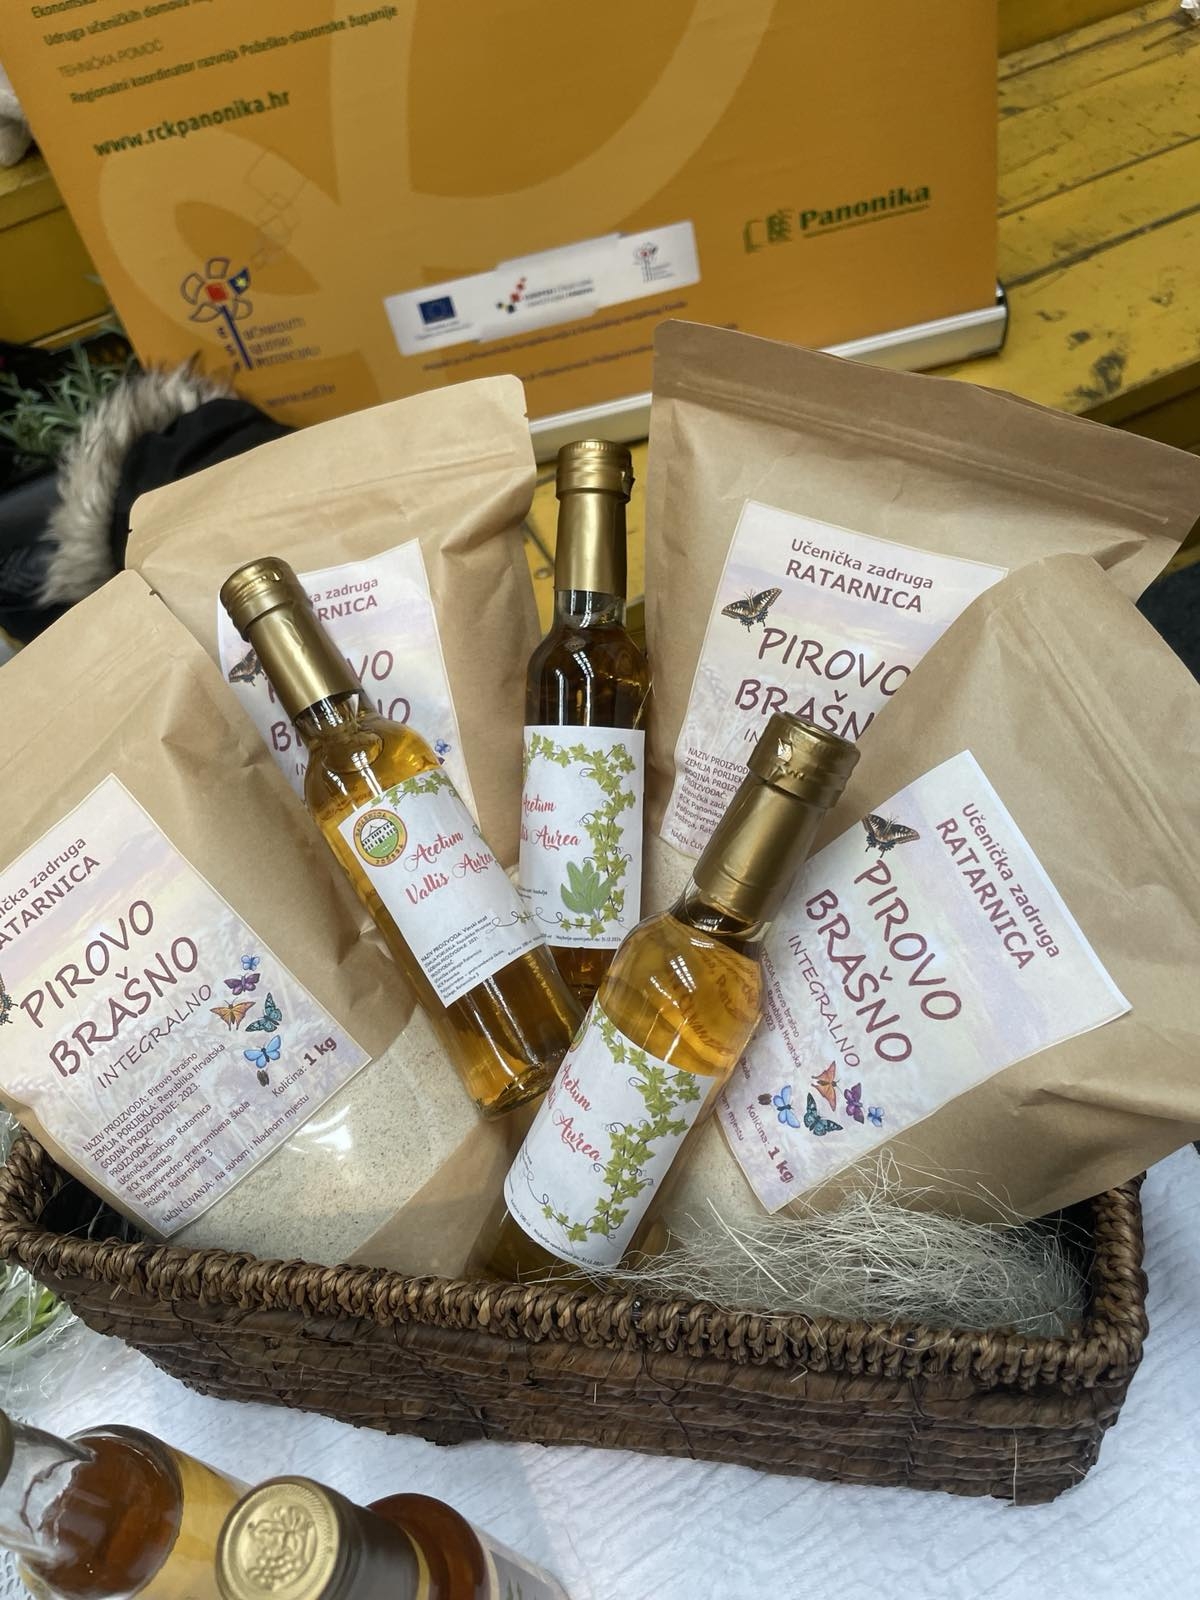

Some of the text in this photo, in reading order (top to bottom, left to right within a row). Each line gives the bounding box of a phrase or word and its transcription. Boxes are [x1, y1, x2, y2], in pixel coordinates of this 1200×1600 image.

[94, 90, 290, 156] www.rckpanonika.hr
[800, 186, 930, 231] Panonika
[326, 579, 378, 600] zadruga
[785, 559, 922, 613] RATARNICA
[791, 538, 934, 589] Učenička zadruga
[317, 594, 378, 621] RNICA
[758, 627, 911, 696] PIROVO
[688, 747, 710, 761] NAZIV
[29, 838, 87, 888] zadruga
[404, 832, 464, 872] Acetum
[531, 825, 580, 851] Aurea
[0, 856, 101, 952] ATARNICA
[406, 872, 449, 904] Vallis
[935, 817, 1035, 969] RATARNICA
[962, 803, 1060, 958] Učenička zadruga
[20, 900, 154, 1029] PIROVO
[854, 859, 962, 1021] PIROVO
[49, 936, 198, 1077] BRAŠNO
[788, 934, 861, 1068] INTEGRALNO
[805, 889, 913, 1063] BRAŠNO
[97, 984, 211, 1089] INTEGRALNO
[773, 981, 787, 1008] Pirovo
[783, 1007, 800, 1039] brašno
[271, 1035, 338, 1099] Količina: 1 kg
[782, 1030, 802, 1069] Hrvatska
[82, 1052, 198, 1152] NAZIV PROIZVODA: Pirovo brašno
[91, 1043, 226, 1161] ZEMLJA PORIJEKLA: Republika Hrvatska
[100, 1081, 201, 1169] GODINA PROIZVODNJE: 2023.
[230, 1100, 251, 1121] škola
[117, 1103, 212, 1186] Učenička zadruga Ratarnica
[161, 1205, 183, 1225] NAČIN
[181, 1181, 216, 1210] ČUVANJA:
[214, 1172, 226, 1183] na
[224, 1149, 251, 1173] suhom
[253, 1117, 286, 1146] hladnom
[284, 1094, 311, 1121] mjestu
[552, 1109, 602, 1162] Aurea
[746, 1104, 794, 1184] Količina: 1 kg
[126, 1154, 173, 1194] RCK Panonika
[143, 1148, 214, 1209] Požega, Ratarnička 3
